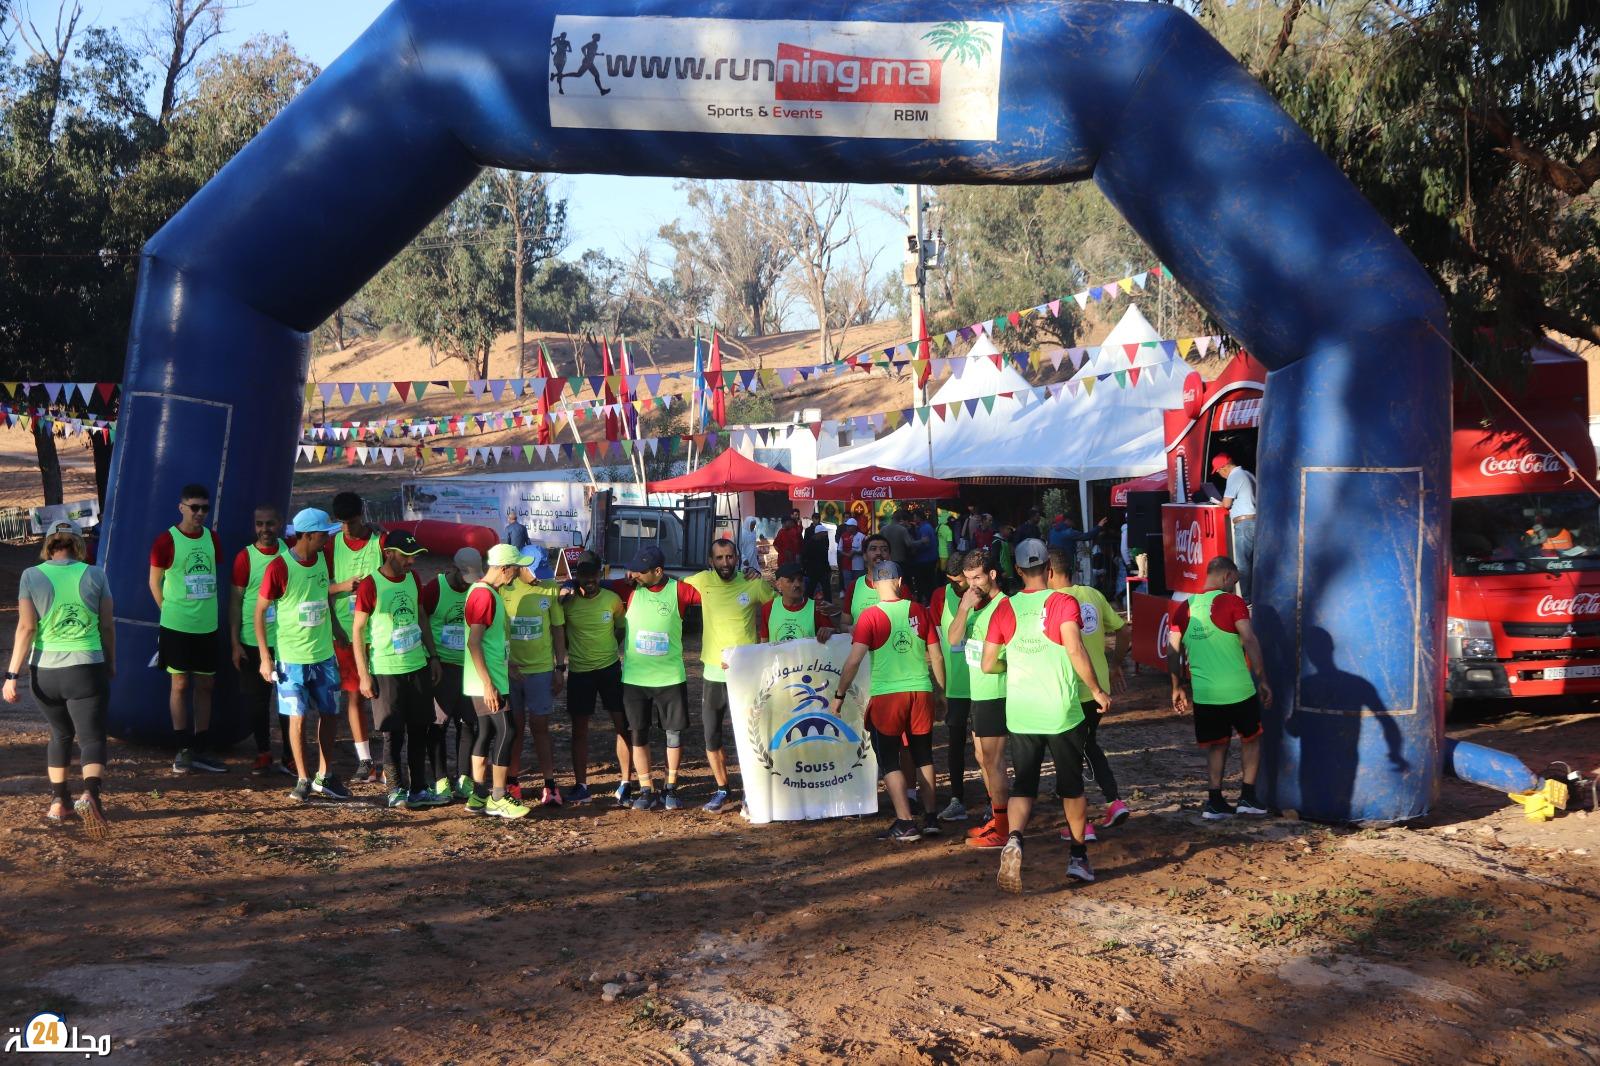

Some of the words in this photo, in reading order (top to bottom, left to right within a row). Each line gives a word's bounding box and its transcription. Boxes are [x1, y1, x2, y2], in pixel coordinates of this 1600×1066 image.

[606, 54, 930, 92] www.running.ma
[707, 104, 754, 118] Sports
[758, 106, 769, 117] &
[773, 105, 823, 119] Events
[894, 109, 929, 121] RBM
[1479, 453, 1562, 477] Coca-Cola
[795, 761, 835, 773] Souss
[783, 772, 853, 789] Ambassadors
